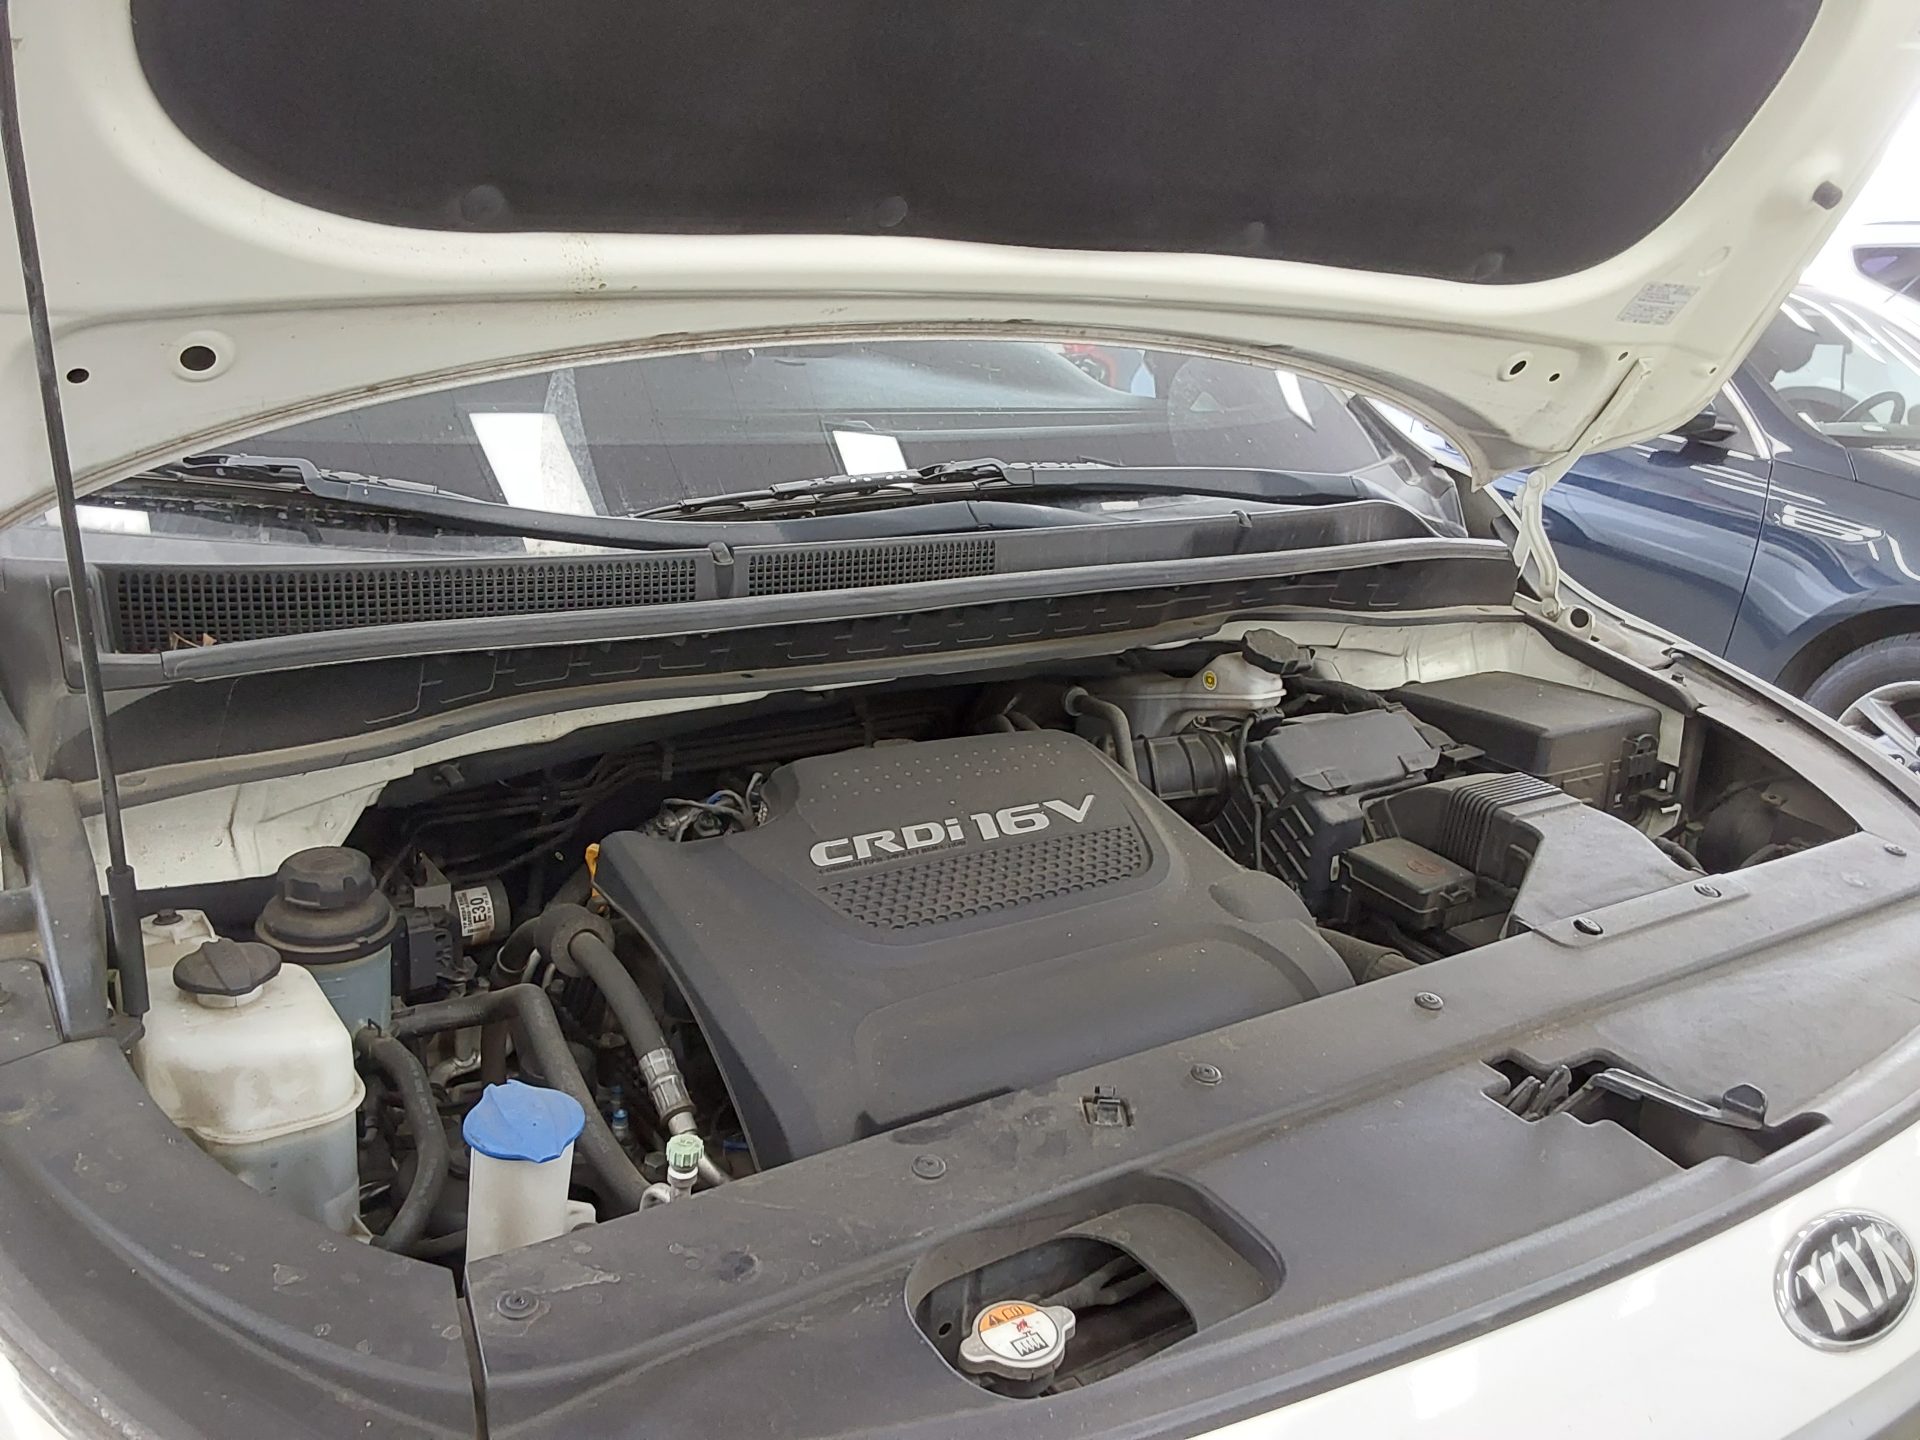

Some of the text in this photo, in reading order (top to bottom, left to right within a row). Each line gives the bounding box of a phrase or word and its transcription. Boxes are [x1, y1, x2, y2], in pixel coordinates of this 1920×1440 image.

[809, 817, 965, 867] CRDi
[969, 794, 1095, 841] 16V
[470, 897, 487, 924] E30
[1796, 1223, 1913, 1333] KIA
